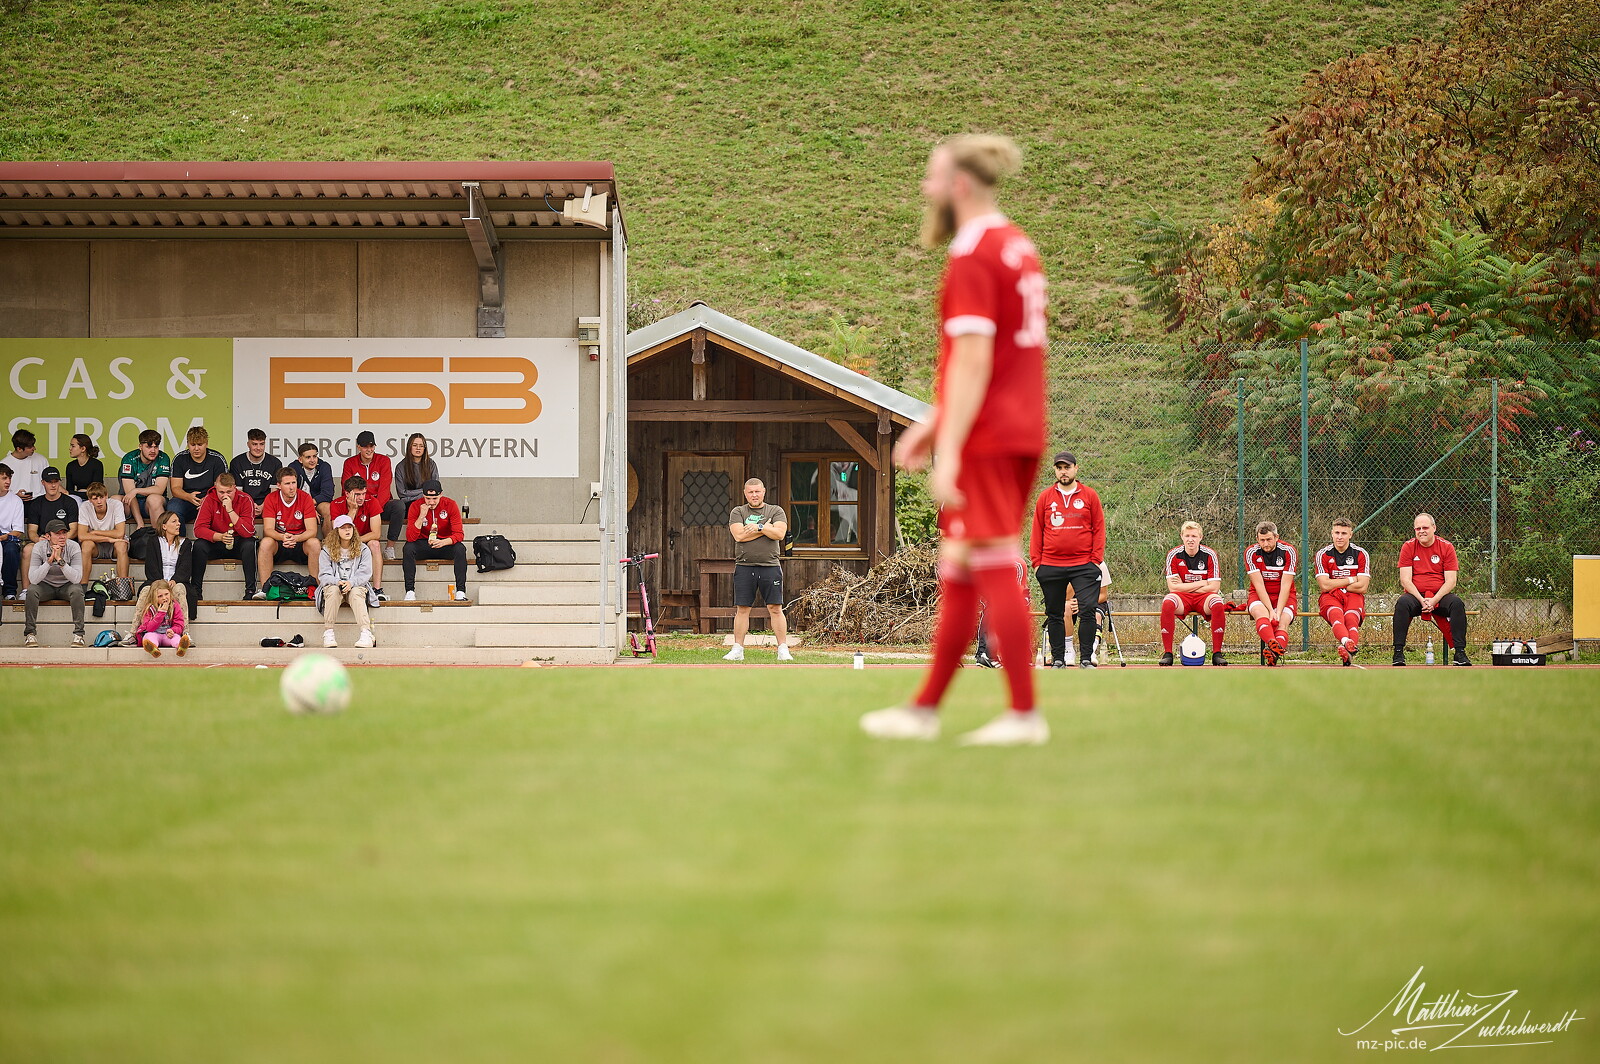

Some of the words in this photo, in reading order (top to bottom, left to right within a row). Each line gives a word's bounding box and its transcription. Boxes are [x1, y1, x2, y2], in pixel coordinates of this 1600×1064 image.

[9, 356, 135, 400] GAS
[166, 356, 208, 400] &
[269, 356, 543, 424] ESB
[0, 416, 204, 458] STROM
[269, 437, 361, 458] ENRG
[255, 470, 273, 480] FAST
